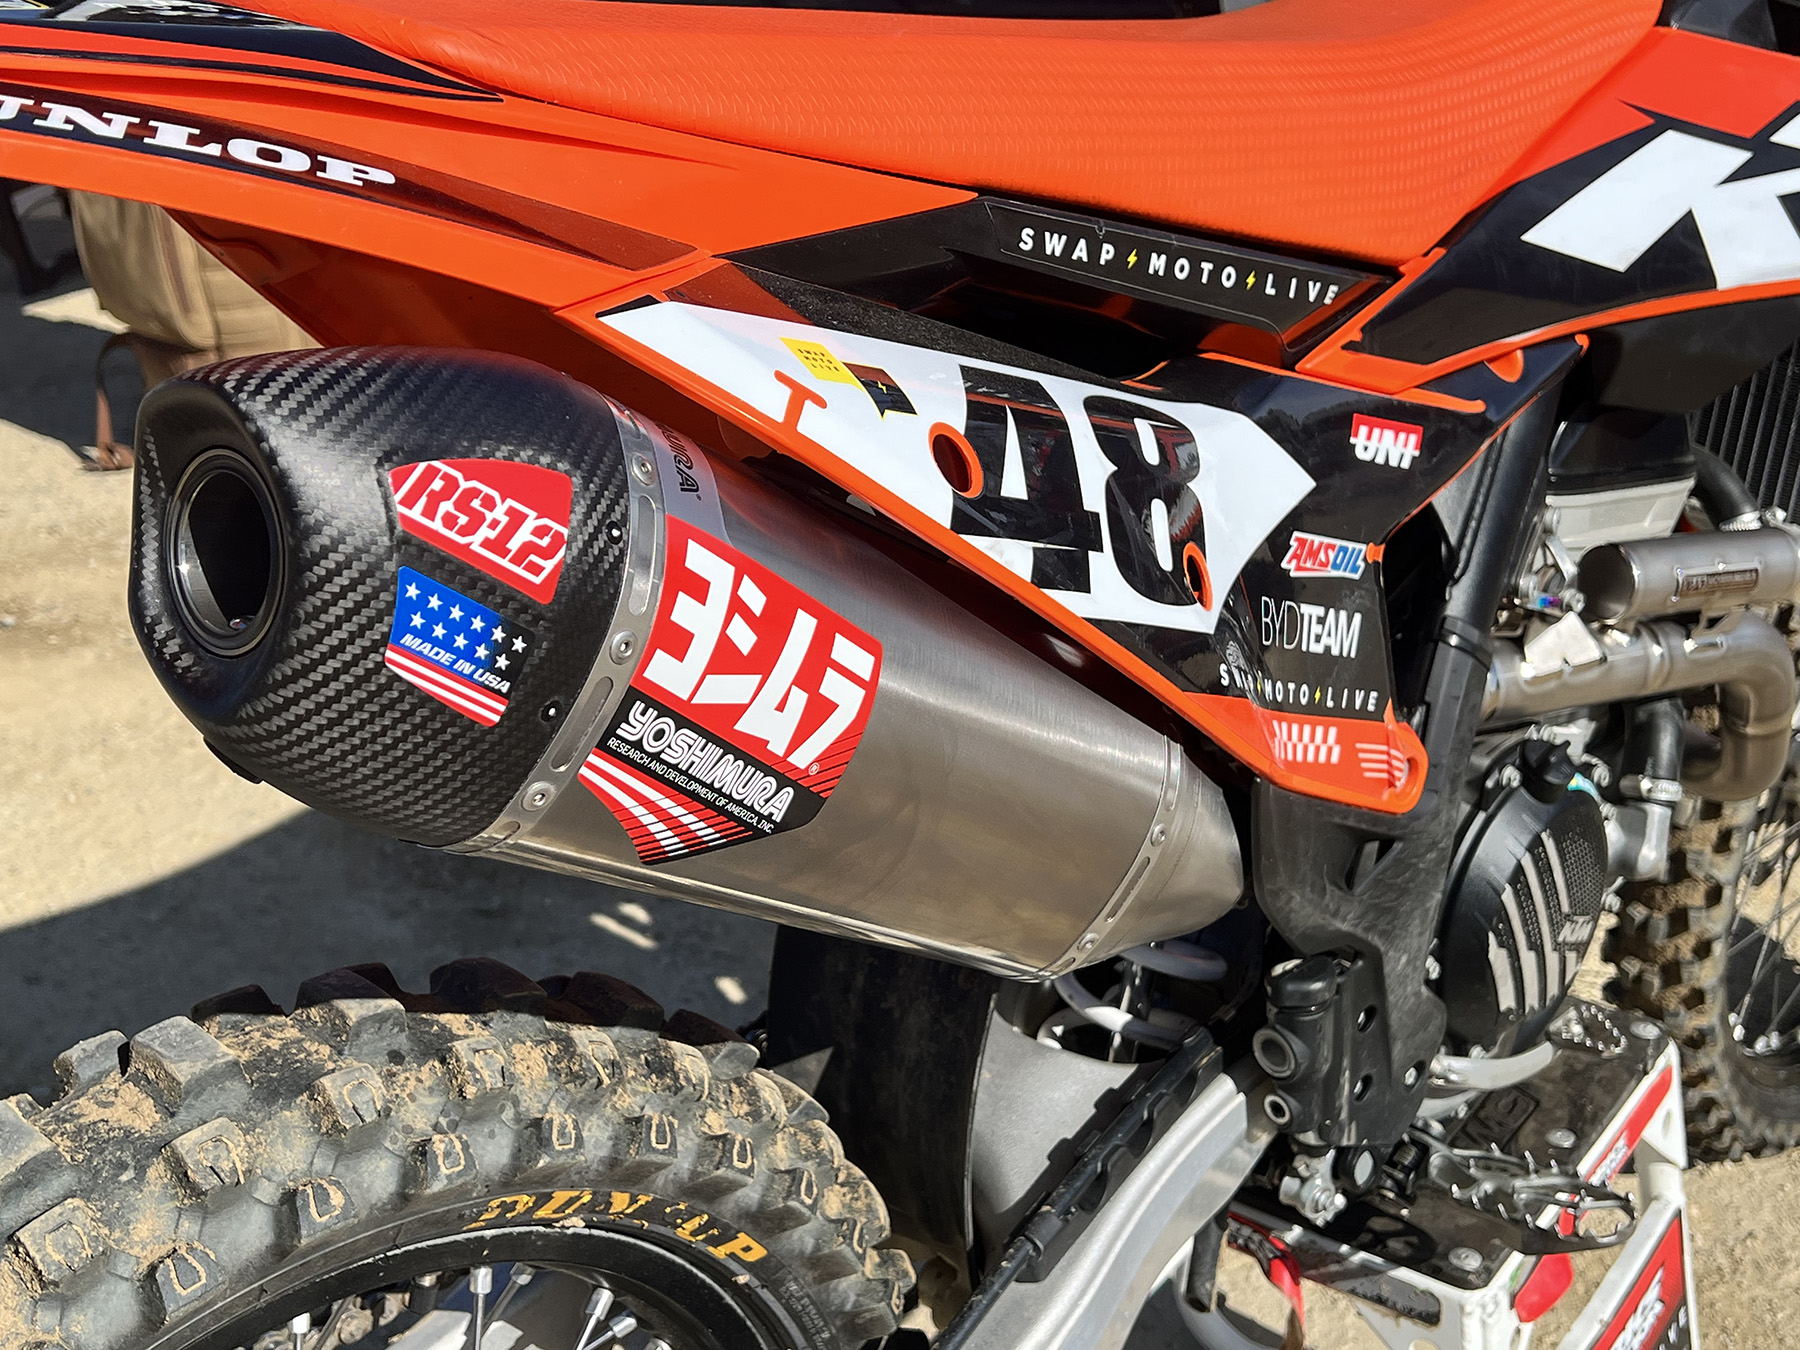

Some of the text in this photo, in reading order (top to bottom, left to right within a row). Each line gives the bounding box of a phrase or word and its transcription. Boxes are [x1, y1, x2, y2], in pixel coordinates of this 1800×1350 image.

[1018, 227, 1340, 305] SWAP MOTO LIVE
[951, 364, 1206, 607] 48
[1349, 423, 1421, 470] UNI
[1284, 534, 1366, 576] AMSOIL
[400, 633, 512, 694] MADE IN USA
[642, 538, 876, 769] ヨシムラ
[1263, 678, 1310, 706] MOTO
[1326, 686, 1379, 712] LIVE
[607, 737, 775, 834] RESEARCH AND DEVELOPMENT OF AMERICA, INC.
[615, 700, 795, 822] YOSHIMURA
